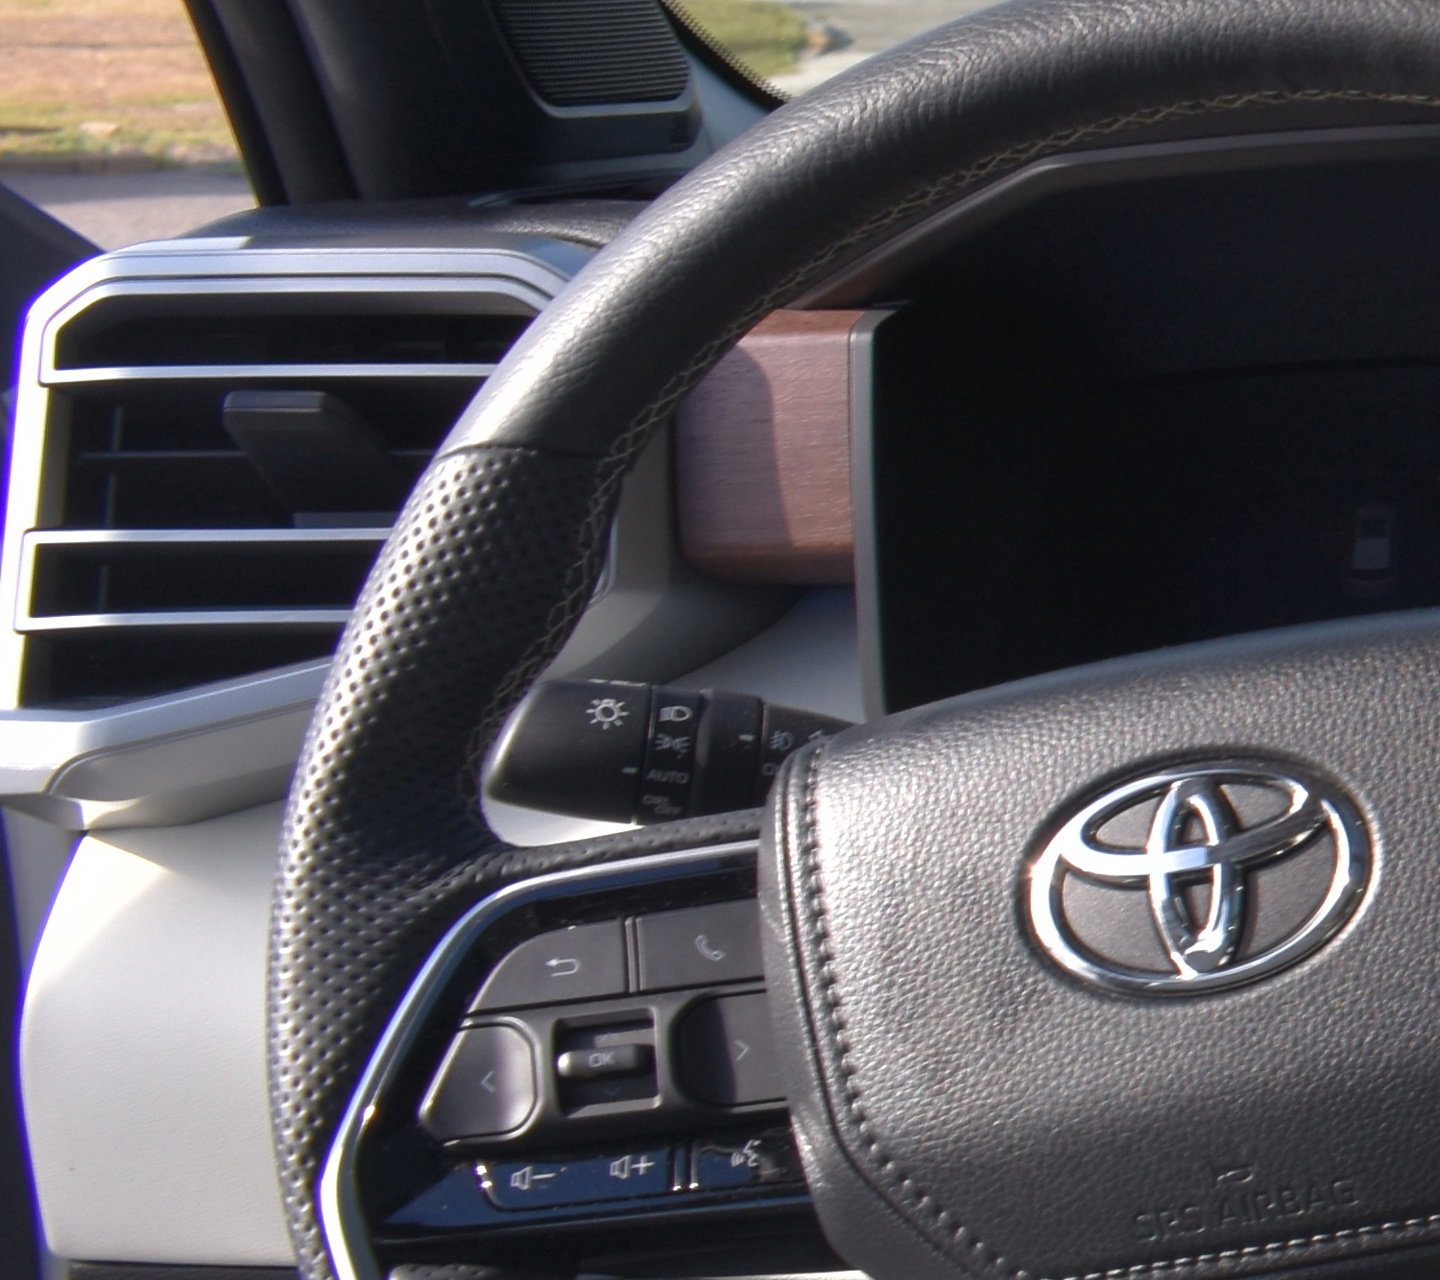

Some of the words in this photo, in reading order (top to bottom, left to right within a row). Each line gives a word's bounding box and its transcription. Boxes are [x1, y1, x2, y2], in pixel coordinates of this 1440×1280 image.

[646, 768, 691, 785] AUTO
[588, 1051, 614, 1068] OK
[1219, 1180, 1362, 1229] AIRBAG
